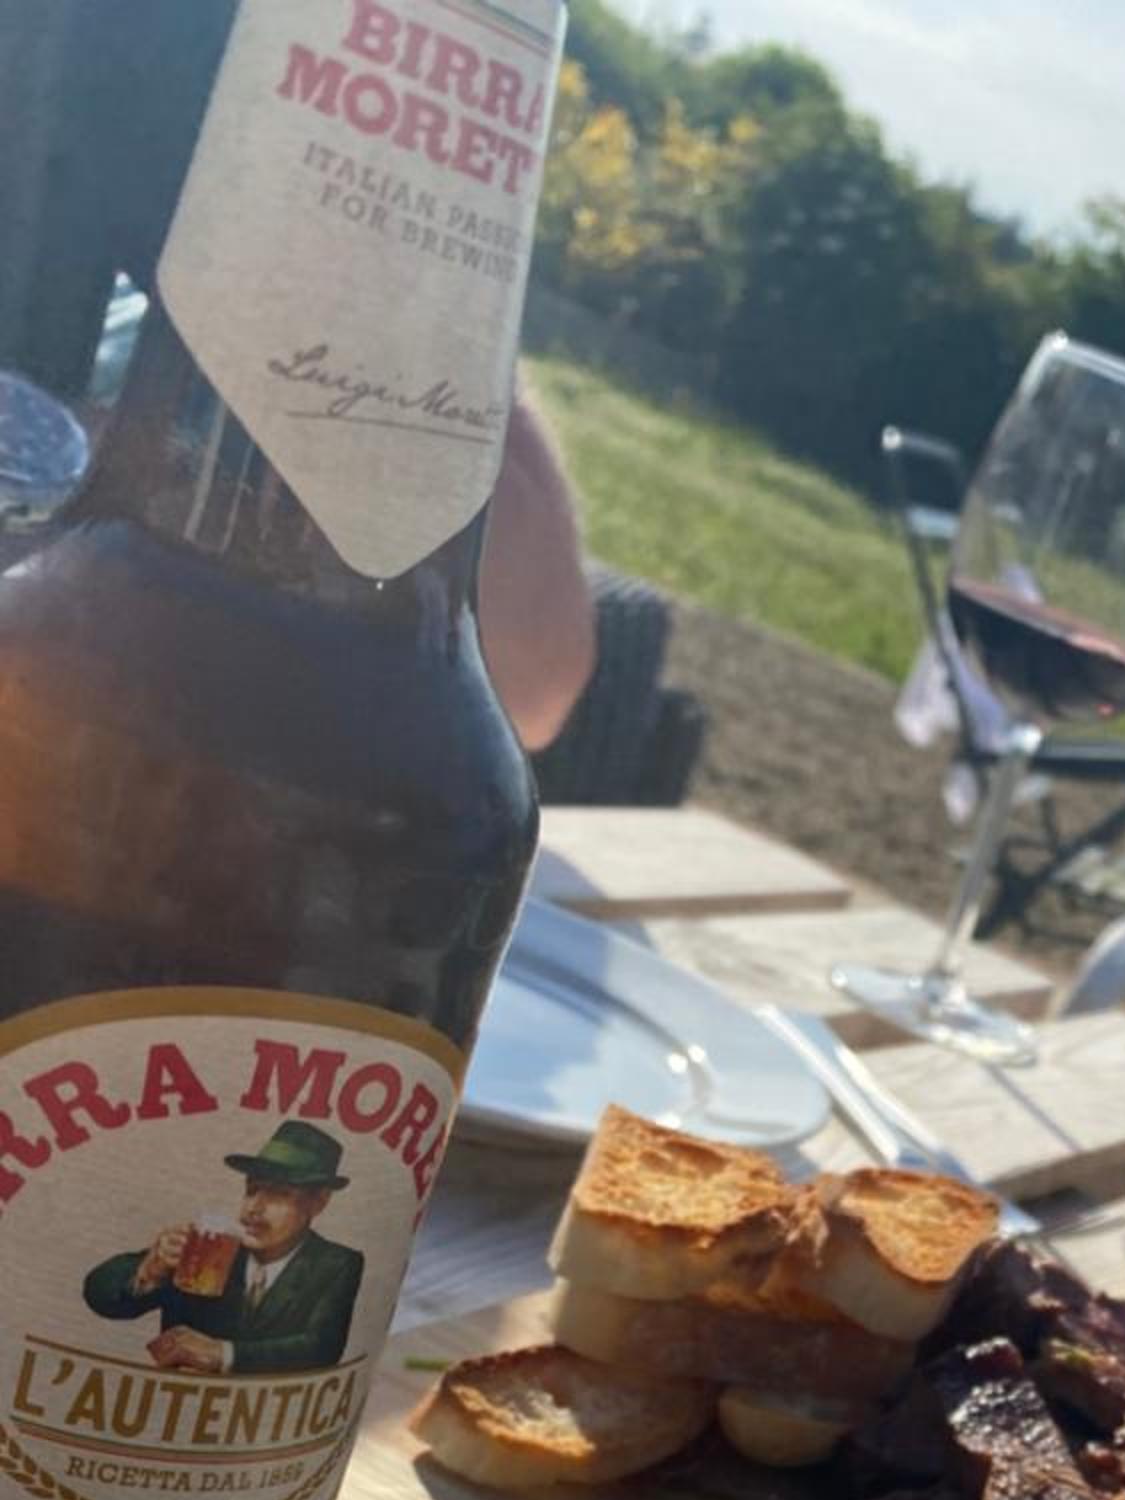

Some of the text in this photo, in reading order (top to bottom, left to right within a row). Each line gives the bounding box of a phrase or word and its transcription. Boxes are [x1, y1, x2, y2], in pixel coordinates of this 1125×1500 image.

[304, 142, 437, 219] ITALIAN
[320, 182, 388, 234] FOR
[239, 1039, 447, 1233] MORE
[13, 1350, 357, 1444] L'AUTENTICA
[66, 1456, 191, 1493] RICETTA
[199, 1472, 252, 1493] DAL
